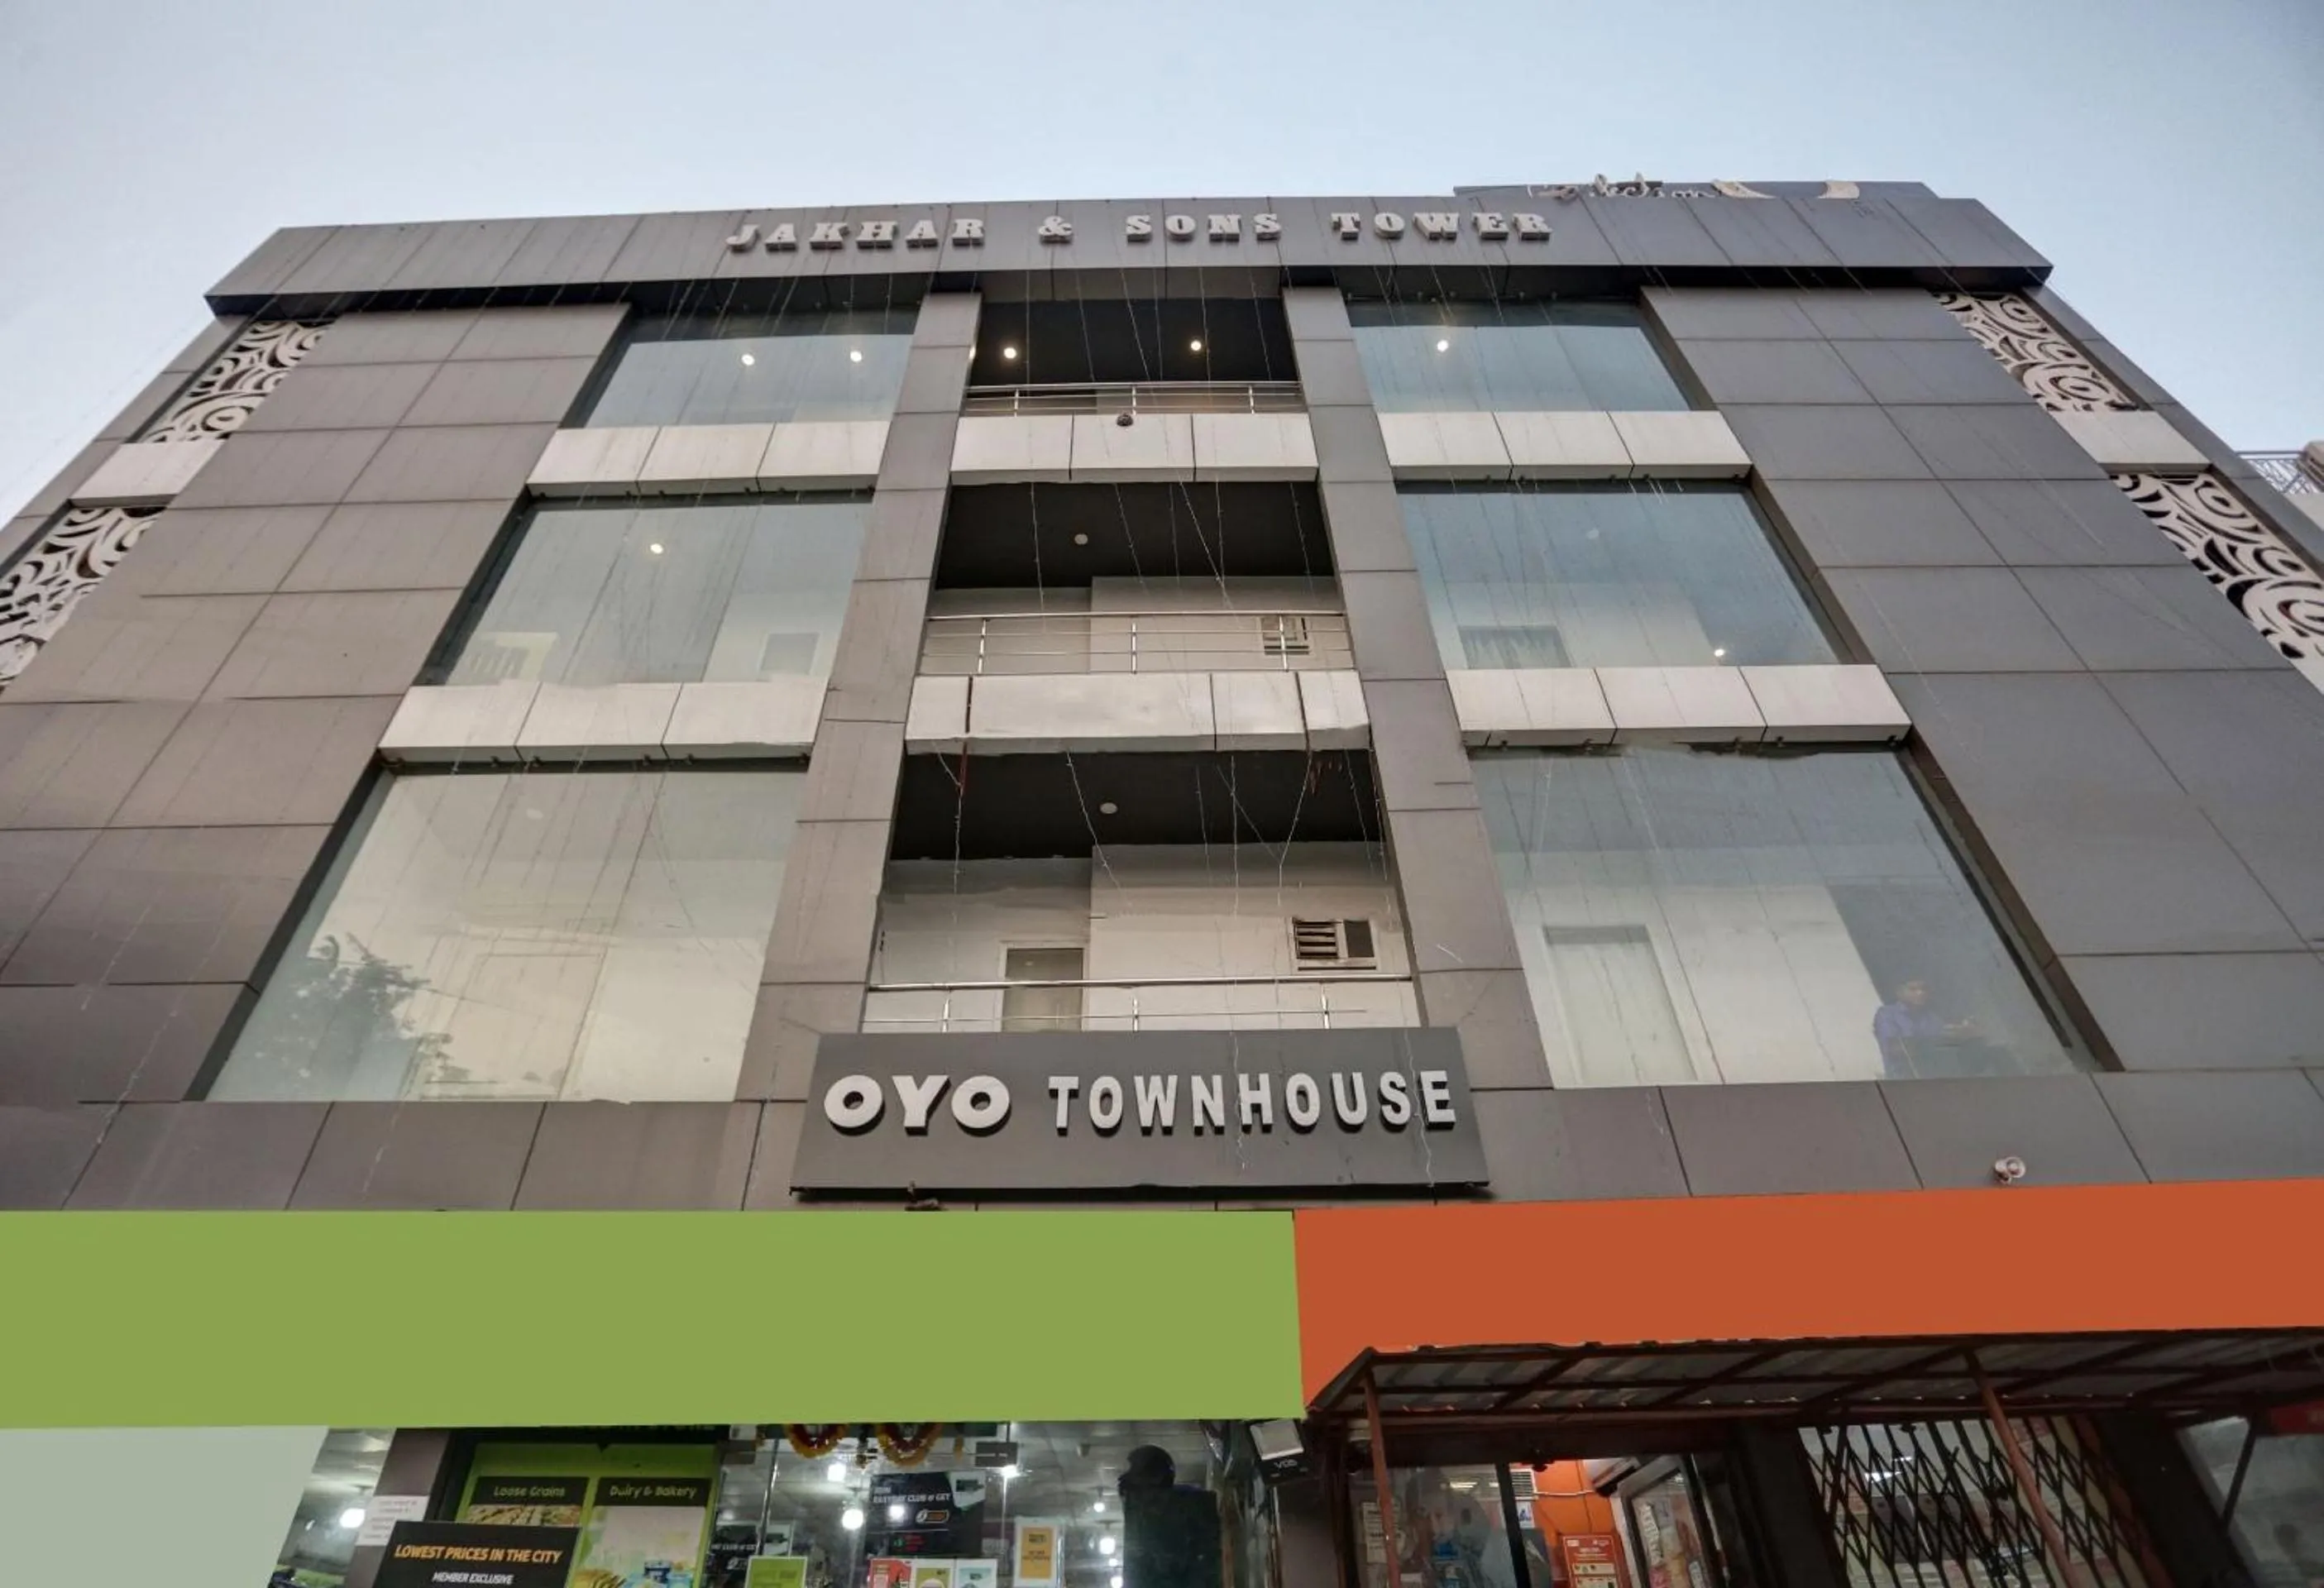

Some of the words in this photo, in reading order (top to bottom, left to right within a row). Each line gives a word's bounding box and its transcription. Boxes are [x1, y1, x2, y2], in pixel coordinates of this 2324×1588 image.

[725, 218, 985, 251] JAKHAR
[1038, 215, 1073, 243] &
[1125, 213, 1282, 242] SONS
[1330, 212, 1552, 240] TOWER
[824, 1074, 1012, 1137] OYO
[1048, 1070, 1456, 1136] TOWNHOUSE
[394, 1543, 443, 1559] LOWEST
[444, 1545, 489, 1562] PRICES
[489, 1547, 504, 1562] IN
[506, 1548, 532, 1563] THE
[532, 1549, 563, 1564] CITY
[432, 1571, 469, 1583] MEMBER
[469, 1572, 514, 1586] EXCLUSIVE
